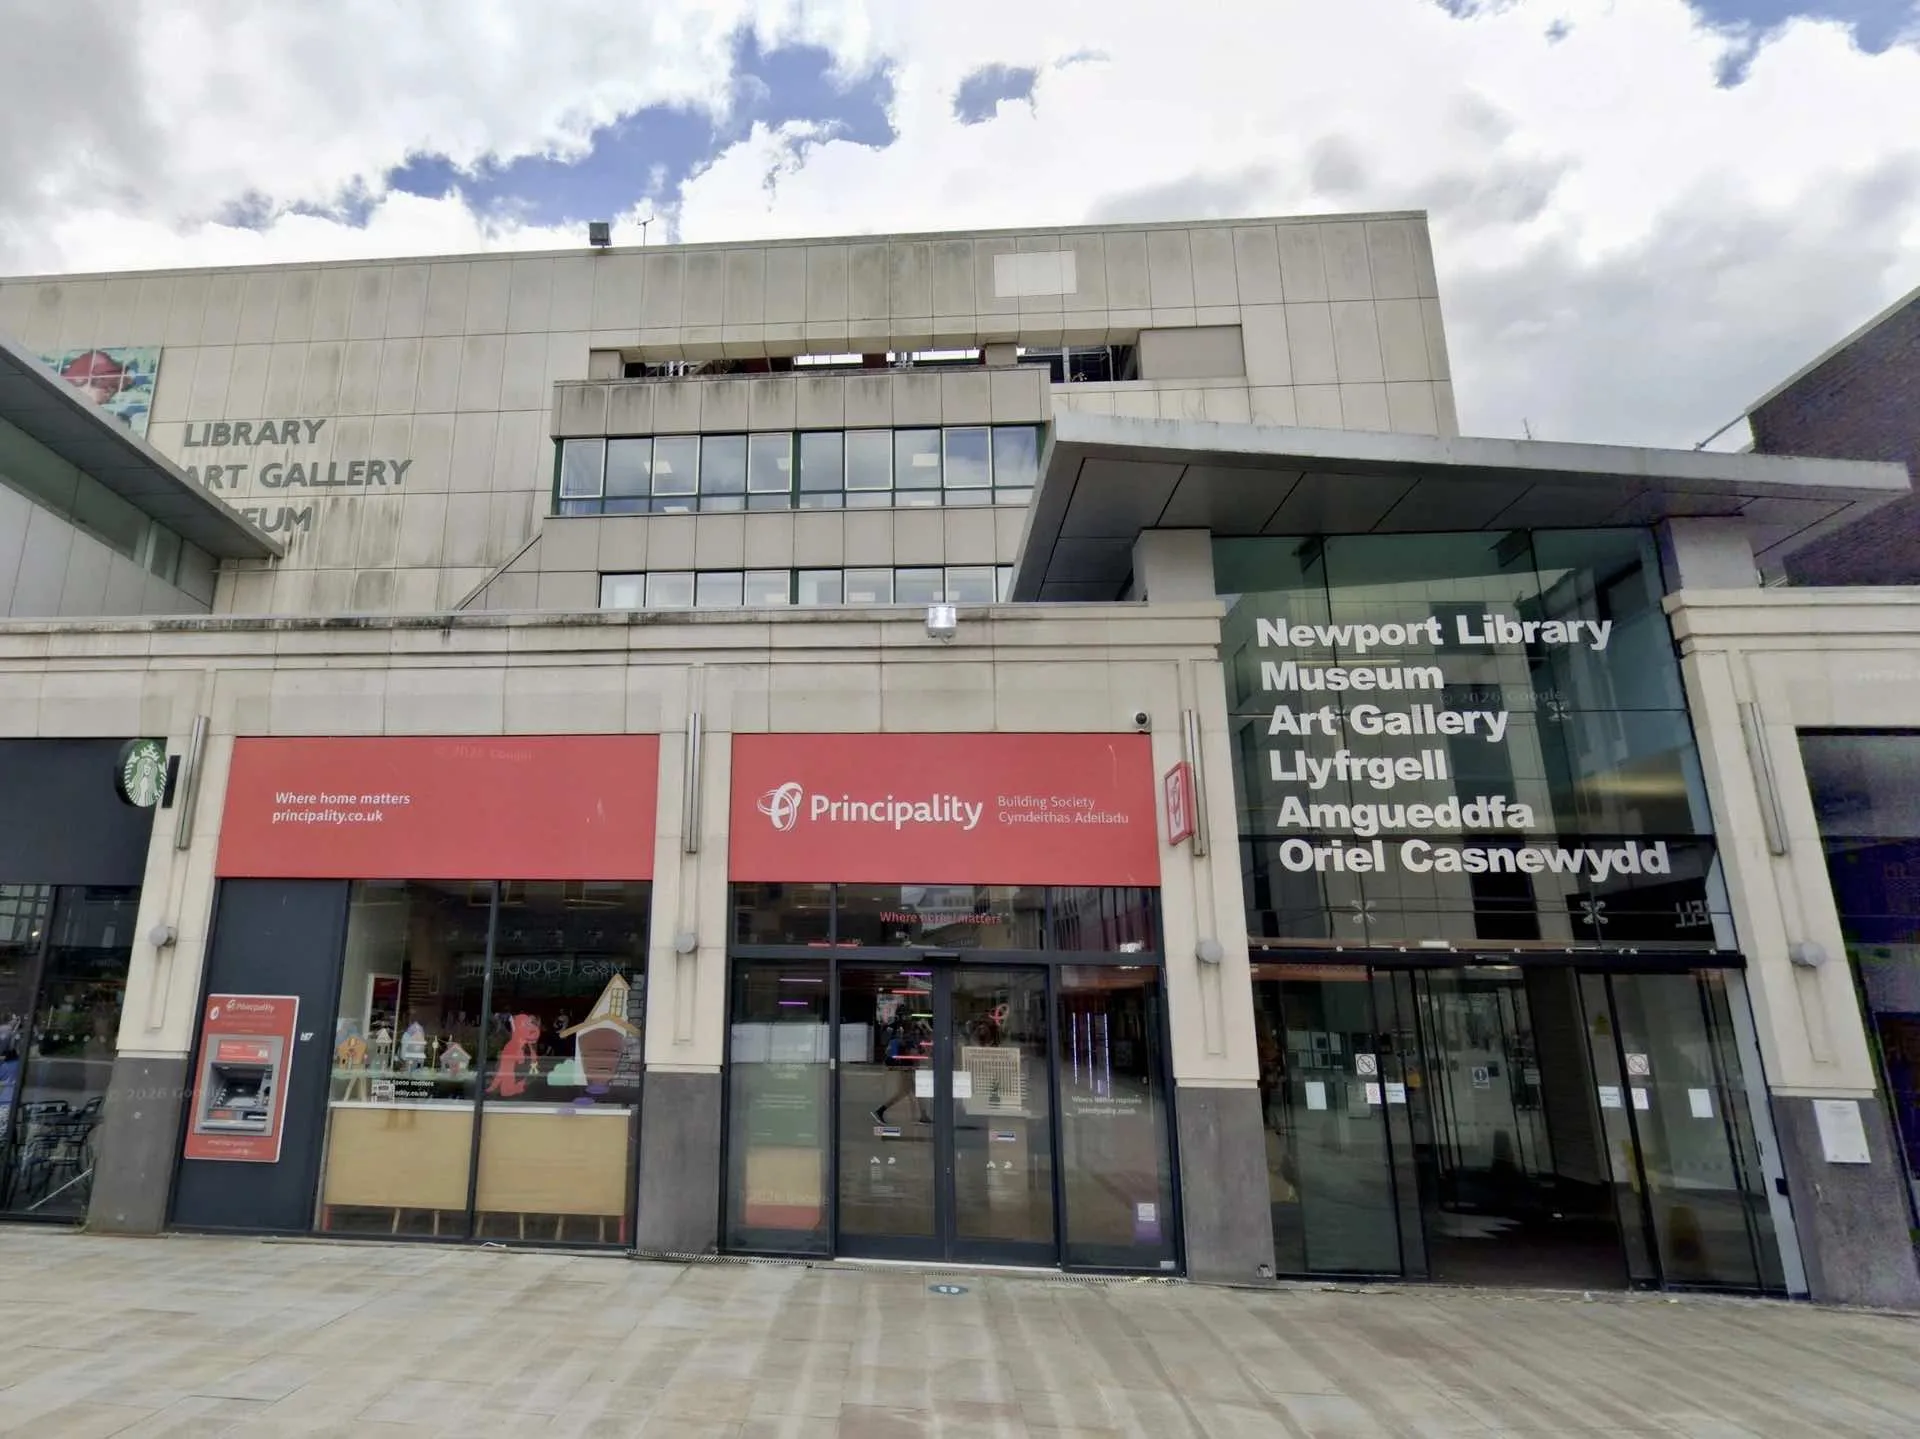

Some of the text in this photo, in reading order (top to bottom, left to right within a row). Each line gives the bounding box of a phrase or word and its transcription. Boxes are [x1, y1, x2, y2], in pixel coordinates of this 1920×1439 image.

[184, 419, 327, 447] LIBRARY
[185, 460, 413, 489] ART GALLERY
[233, 507, 312, 532] EUM
[1256, 613, 1613, 653] Newport Library
[1260, 660, 1445, 692] Museum
[1268, 704, 1509, 742] Art Gallery
[1270, 749, 1448, 790] Llyfrgell
[275, 791, 411, 805] Where home matters
[810, 793, 984, 830] Principality
[998, 795, 1095, 810] Building Society
[272, 808, 383, 825] principality.co.uk
[999, 811, 1129, 825] Cymdeithas Adeiladu
[1277, 796, 1535, 836] Amgueddfa
[1279, 839, 1672, 883] Oriel Casnewydd
